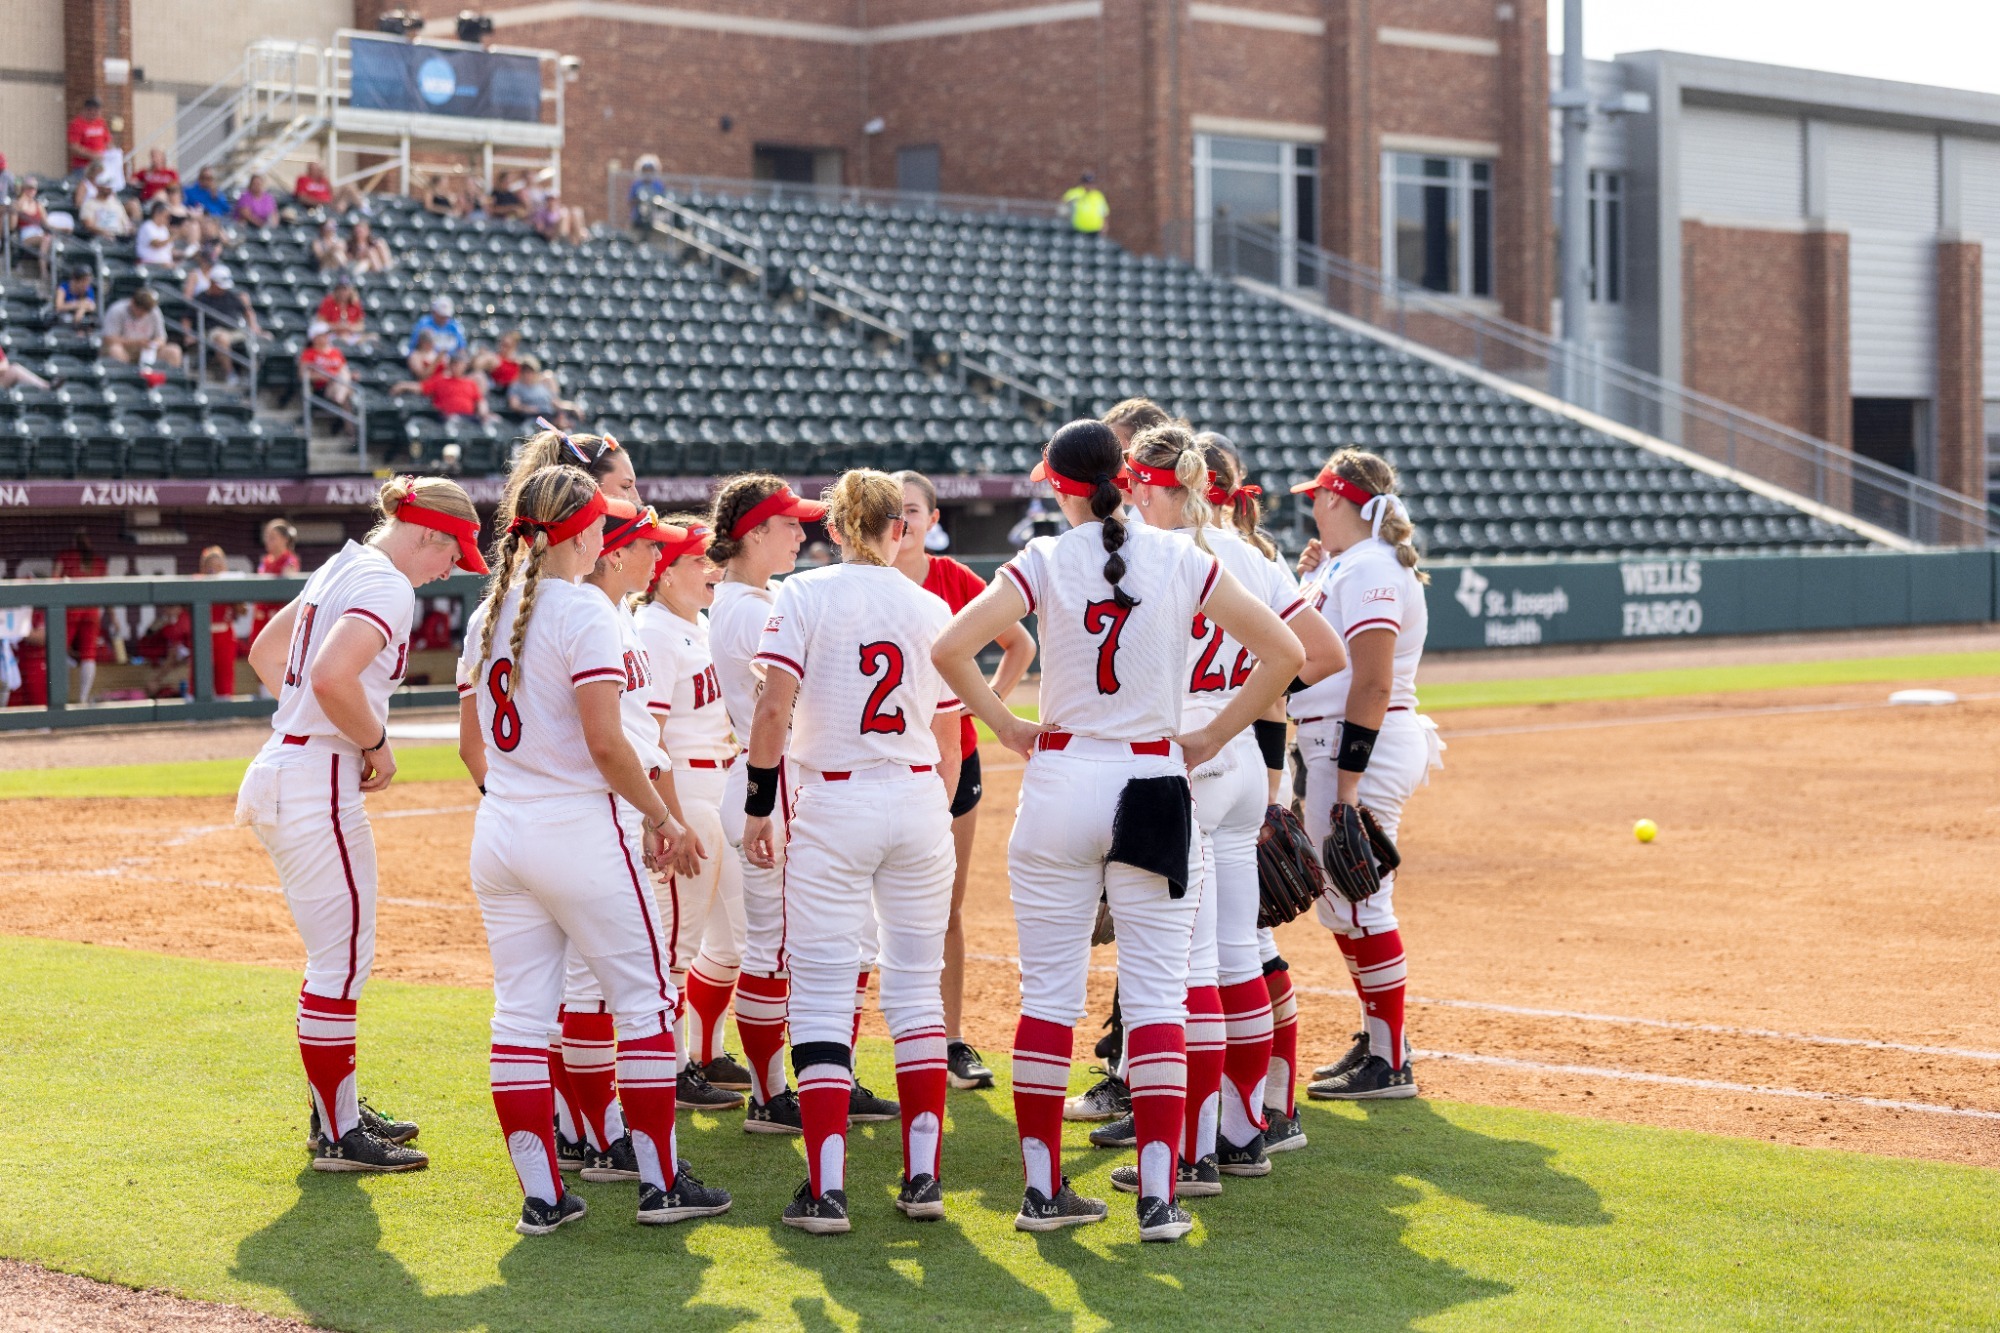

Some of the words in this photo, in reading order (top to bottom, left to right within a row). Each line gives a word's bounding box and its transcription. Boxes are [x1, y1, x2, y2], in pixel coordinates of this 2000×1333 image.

[80, 484, 159, 506] AZUNA
[206, 484, 282, 506] AZUNA
[1620, 561, 1702, 595] WELLS
[1362, 587, 1396, 603] NEC
[1512, 586, 1568, 621] Joseph
[1485, 618, 1542, 646] Health
[1622, 600, 1703, 636] FARGO
[1084, 599, 1133, 695] 7
[859, 641, 906, 735] 2
[487, 657, 523, 752] 8
[562, 1146, 581, 1158] UA
[1228, 1152, 1252, 1162] UA
[1041, 1204, 1059, 1214] UA
